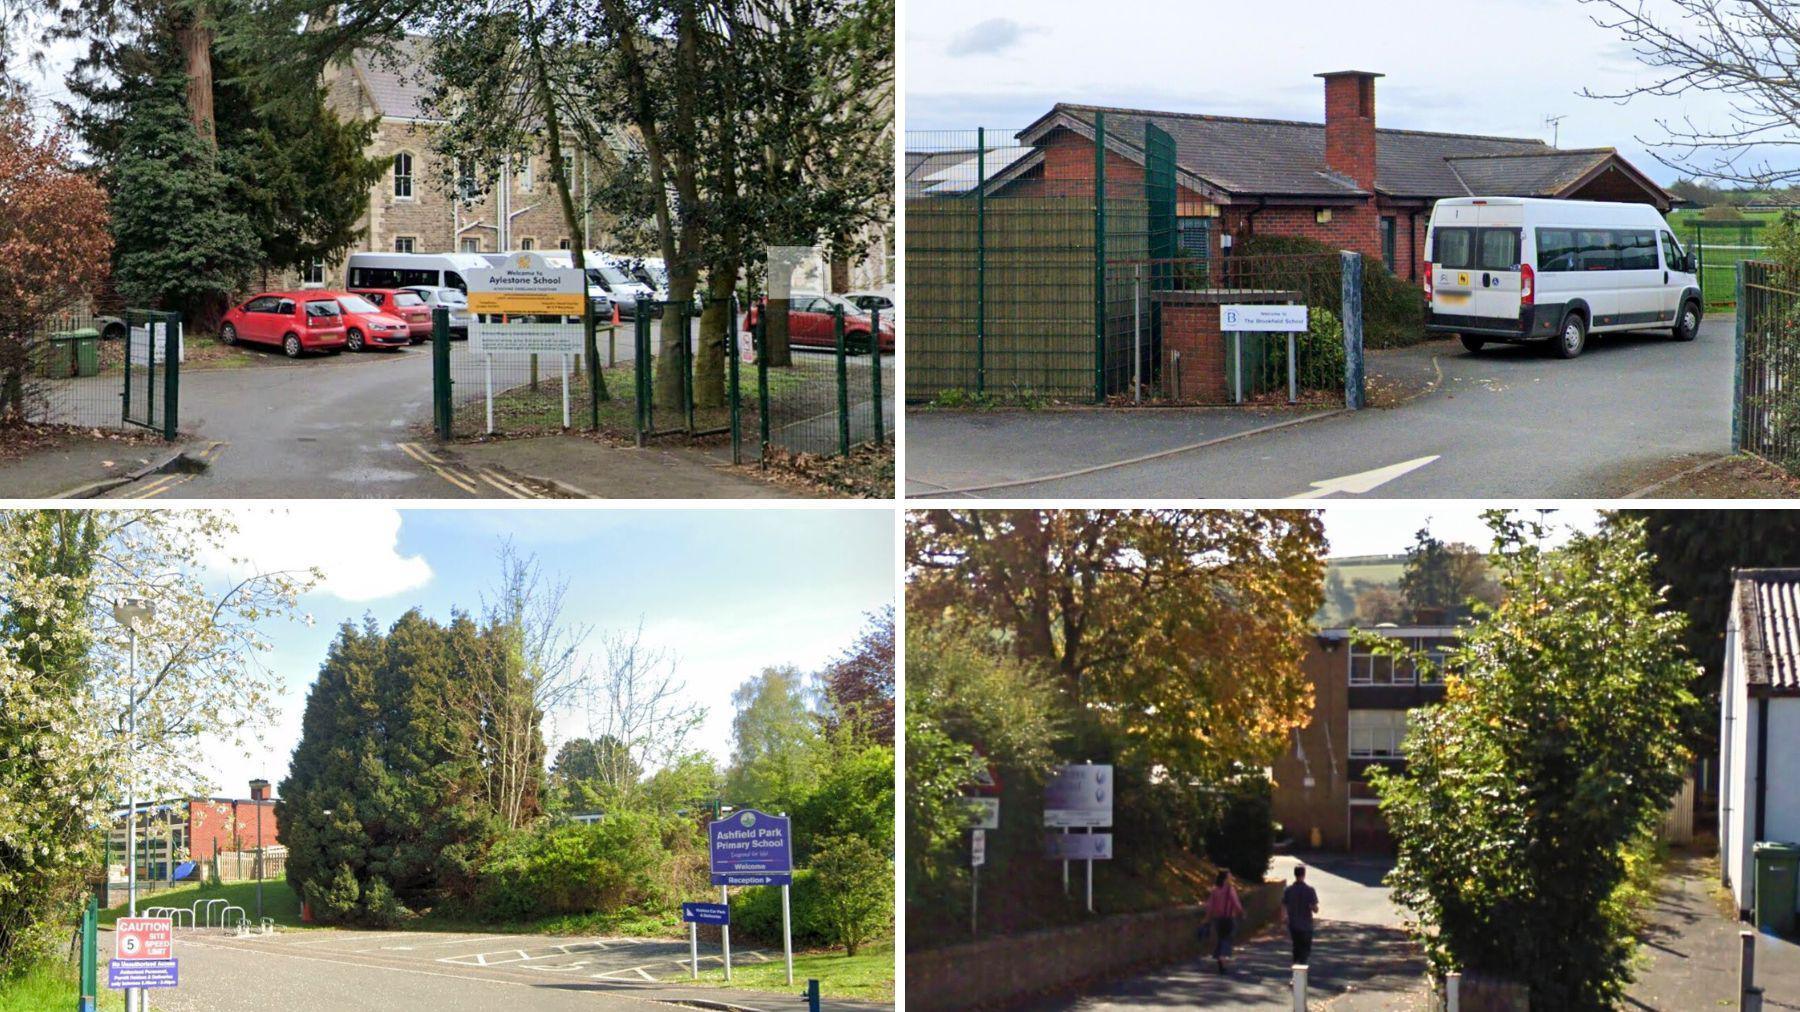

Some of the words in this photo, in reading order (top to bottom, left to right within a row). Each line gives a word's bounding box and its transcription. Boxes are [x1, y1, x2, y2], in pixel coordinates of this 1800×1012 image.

[489, 276, 530, 284] Aylestone
[533, 276, 561, 284] School
[717, 829, 756, 840] Ashfield
[758, 828, 782, 838] Park
[716, 841, 750, 850] Primary
[752, 839, 783, 848] School
[119, 922, 169, 931] CAUTION
[127, 939, 134, 950] 5
